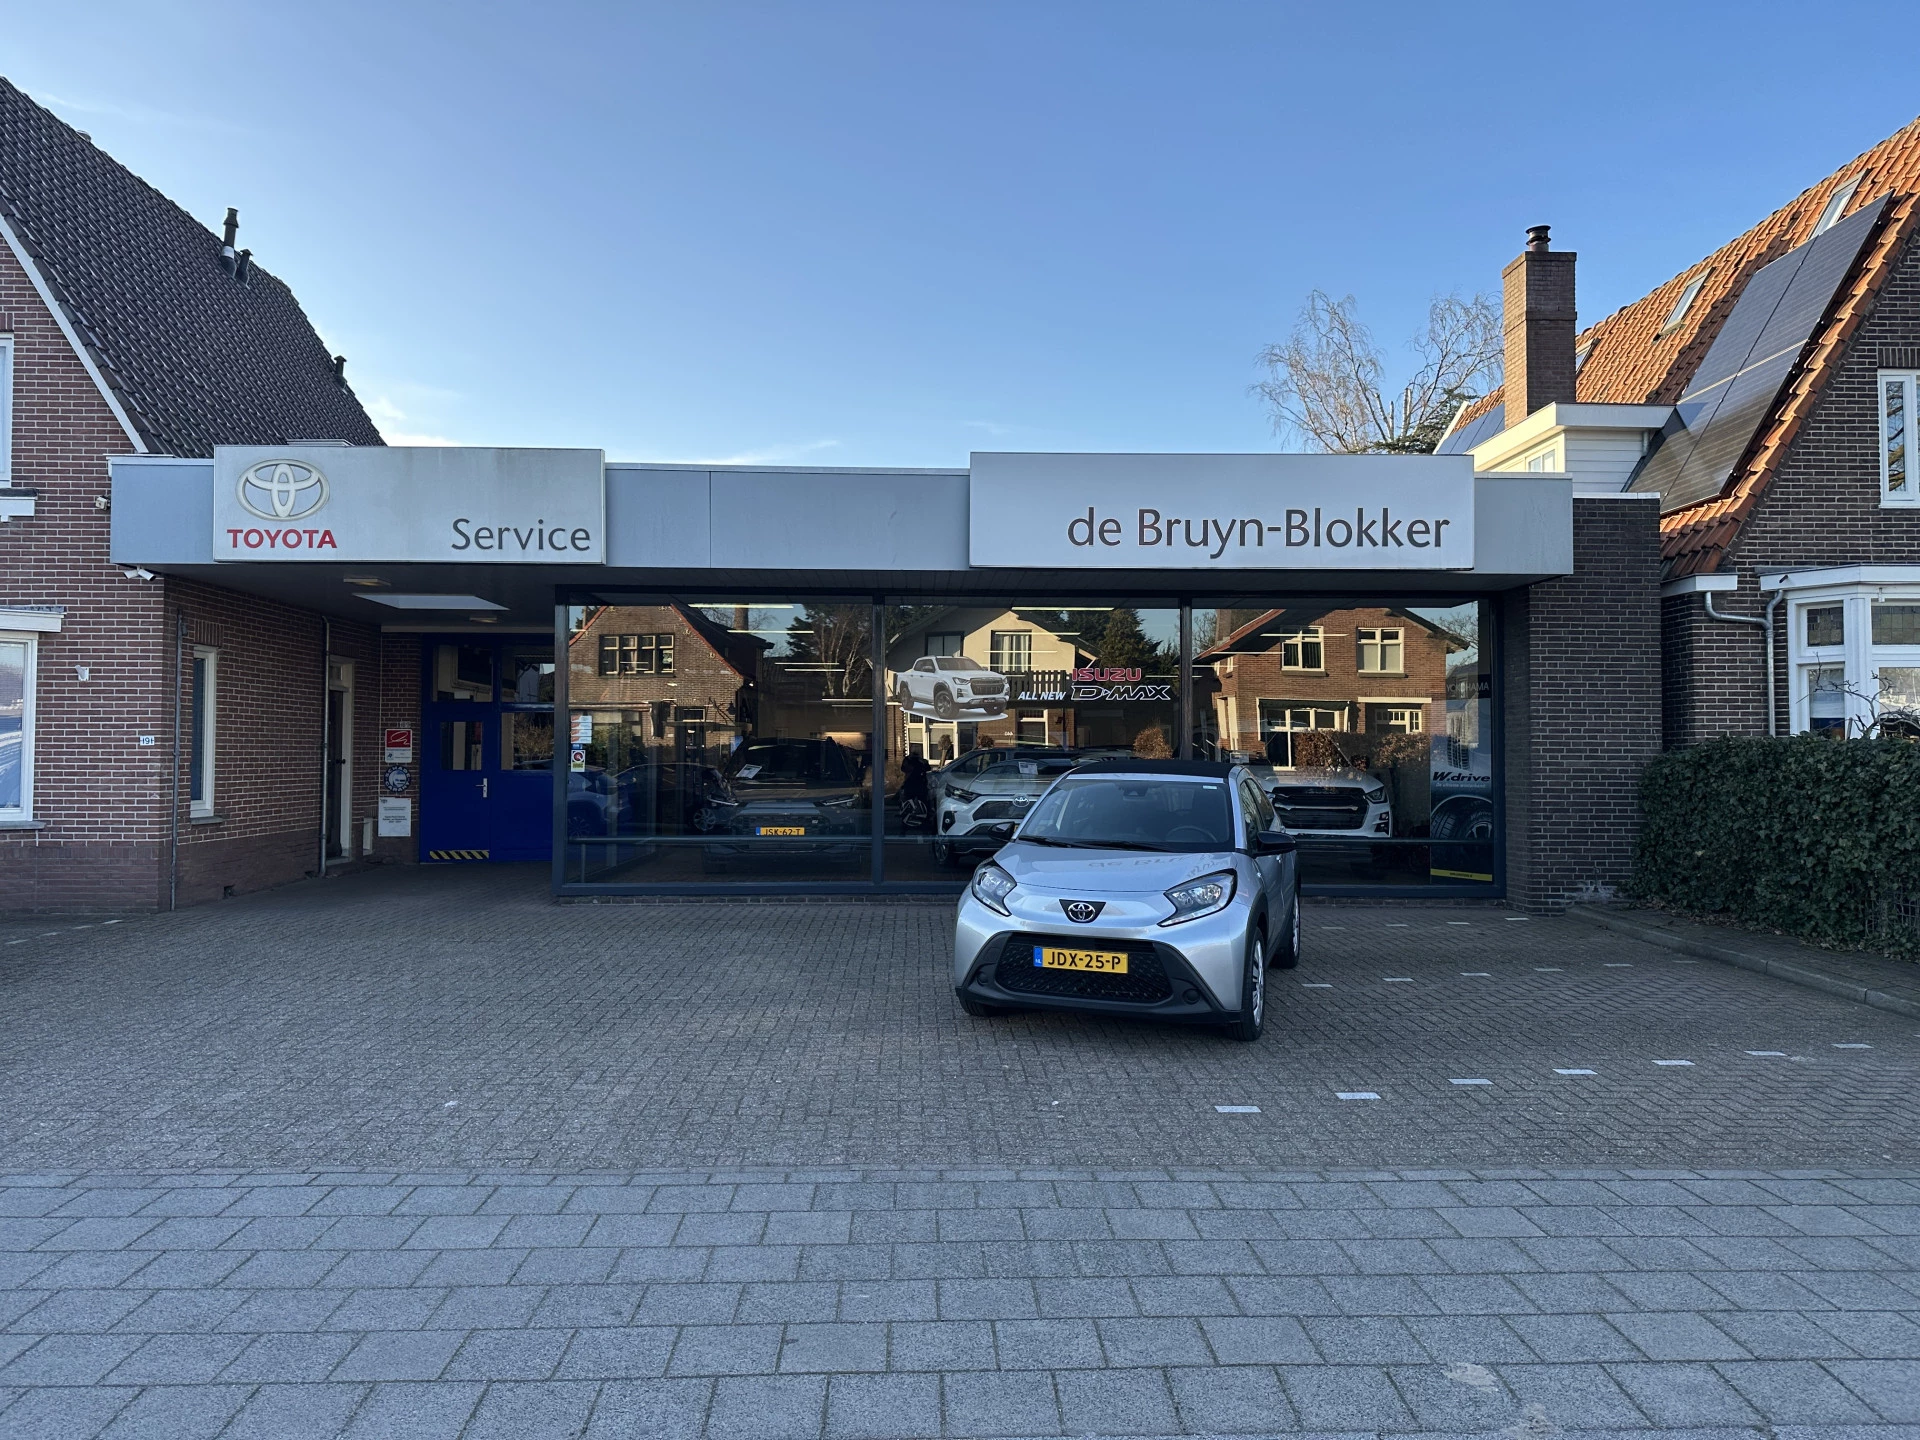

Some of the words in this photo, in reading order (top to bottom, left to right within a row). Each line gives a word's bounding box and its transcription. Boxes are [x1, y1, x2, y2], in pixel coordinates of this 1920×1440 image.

[226, 528, 338, 550] TOYOTA
[451, 518, 591, 552] Service
[1067, 506, 1122, 547] de
[1137, 507, 1451, 560] Bruyn-Blokker
[1071, 667, 1142, 682] ISUZU
[1017, 691, 1038, 700] ALL
[1040, 691, 1067, 700] NEW
[1433, 771, 1491, 782] W.drive
[1048, 951, 1121, 970] JDX-25-P
